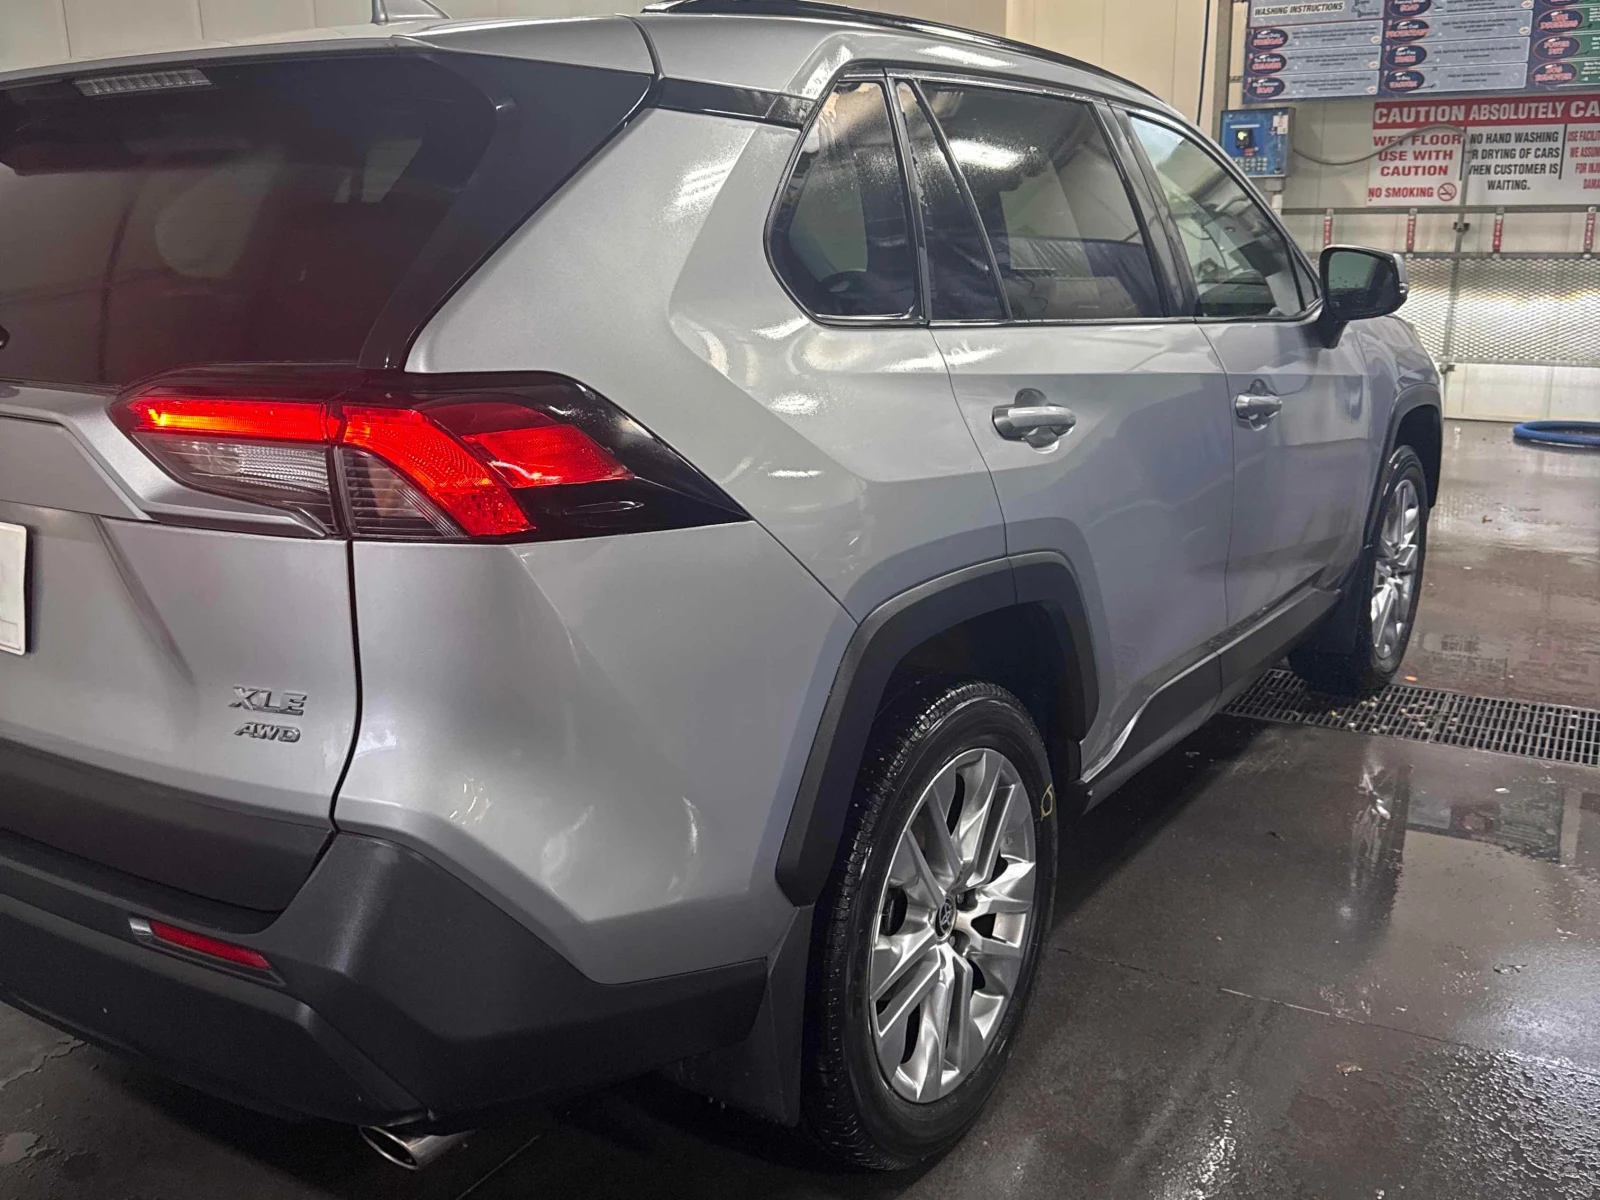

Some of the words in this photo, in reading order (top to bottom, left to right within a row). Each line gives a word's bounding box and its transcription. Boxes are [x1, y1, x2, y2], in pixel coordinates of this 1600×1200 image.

[1254, 6, 1288, 16] WASHING
[1290, 2, 1344, 14] INSTRUCTIONS
[1374, 105, 1465, 124] CAUTION
[1468, 101, 1566, 120] ABSOLUTELY
[1411, 134, 1462, 146] FLOOR
[1470, 132, 1484, 144] NO
[1486, 132, 1512, 144] HAND
[1514, 131, 1559, 142] WASHING
[1378, 150, 1407, 162] USE
[1413, 150, 1454, 160] WITH
[1481, 148, 1516, 160] DRYING
[1519, 148, 1532, 158] OF
[1534, 147, 1560, 158] CARS
[1380, 165, 1448, 176] CAUTION
[1494, 163, 1546, 175] CUSTOMER
[1549, 163, 1558, 174] IS
[1487, 179, 1531, 190] WAITING.
[1368, 188, 1382, 198] NO
[1384, 186, 1434, 198] SMOKING
[228, 685, 307, 716] XLE
[234, 721, 301, 743] AWD
